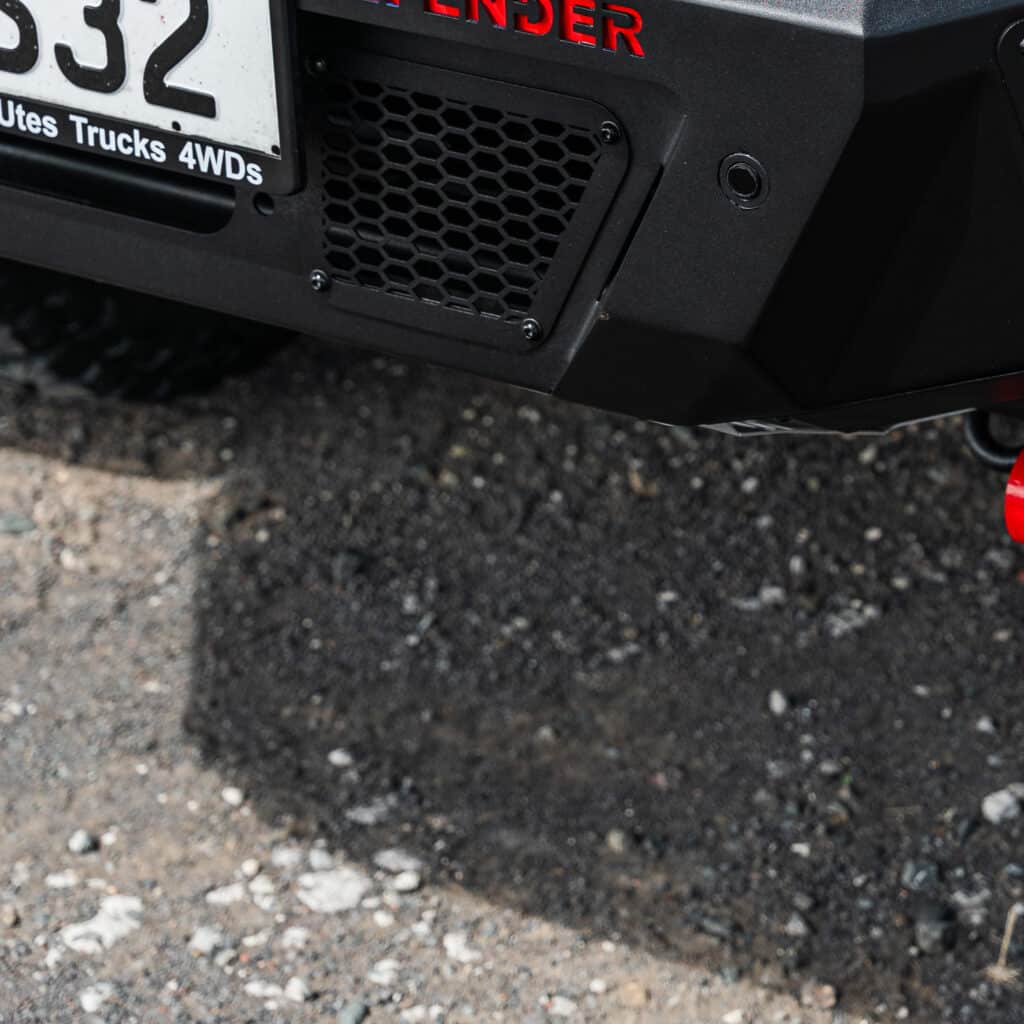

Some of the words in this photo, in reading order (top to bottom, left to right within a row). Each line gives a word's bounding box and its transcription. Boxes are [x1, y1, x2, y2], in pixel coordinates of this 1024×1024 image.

[0, 98, 59, 138] Utes
[68, 113, 167, 163] Trucks
[178, 141, 264, 186] 4WDs
